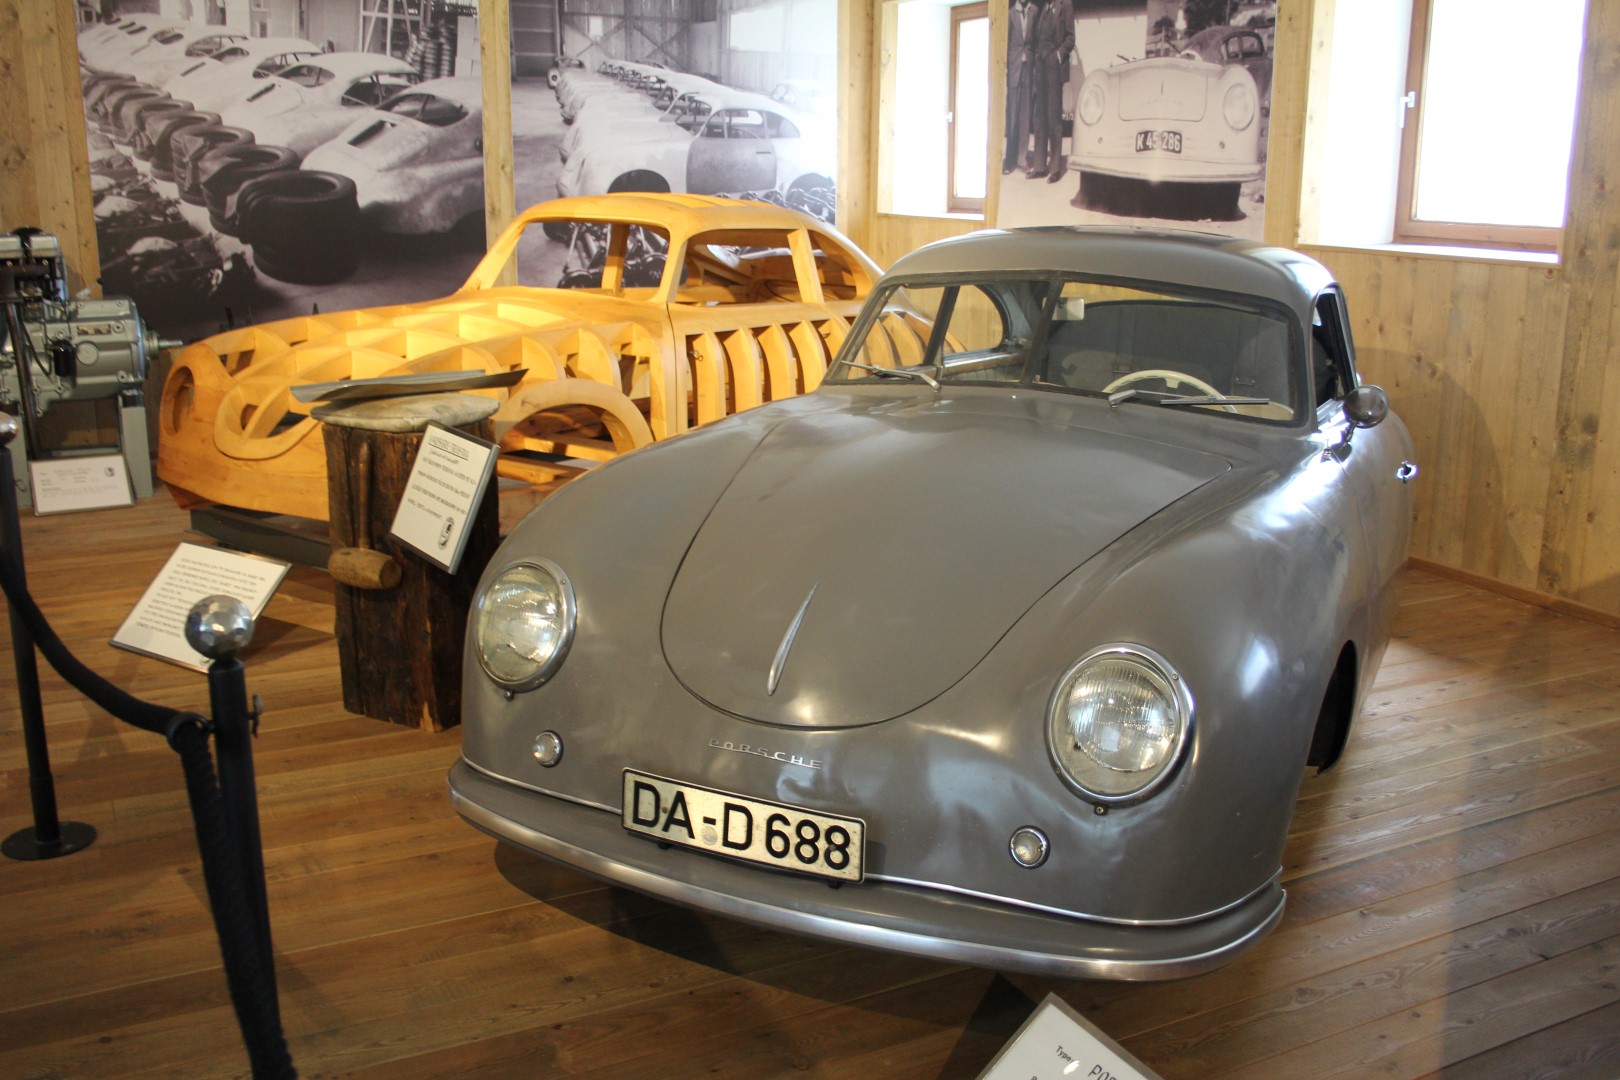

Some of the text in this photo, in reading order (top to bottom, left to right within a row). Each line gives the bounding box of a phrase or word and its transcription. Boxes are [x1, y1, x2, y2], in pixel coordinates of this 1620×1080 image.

[708, 738, 823, 769] PORSCHE
[631, 779, 851, 871] DA-D 688
